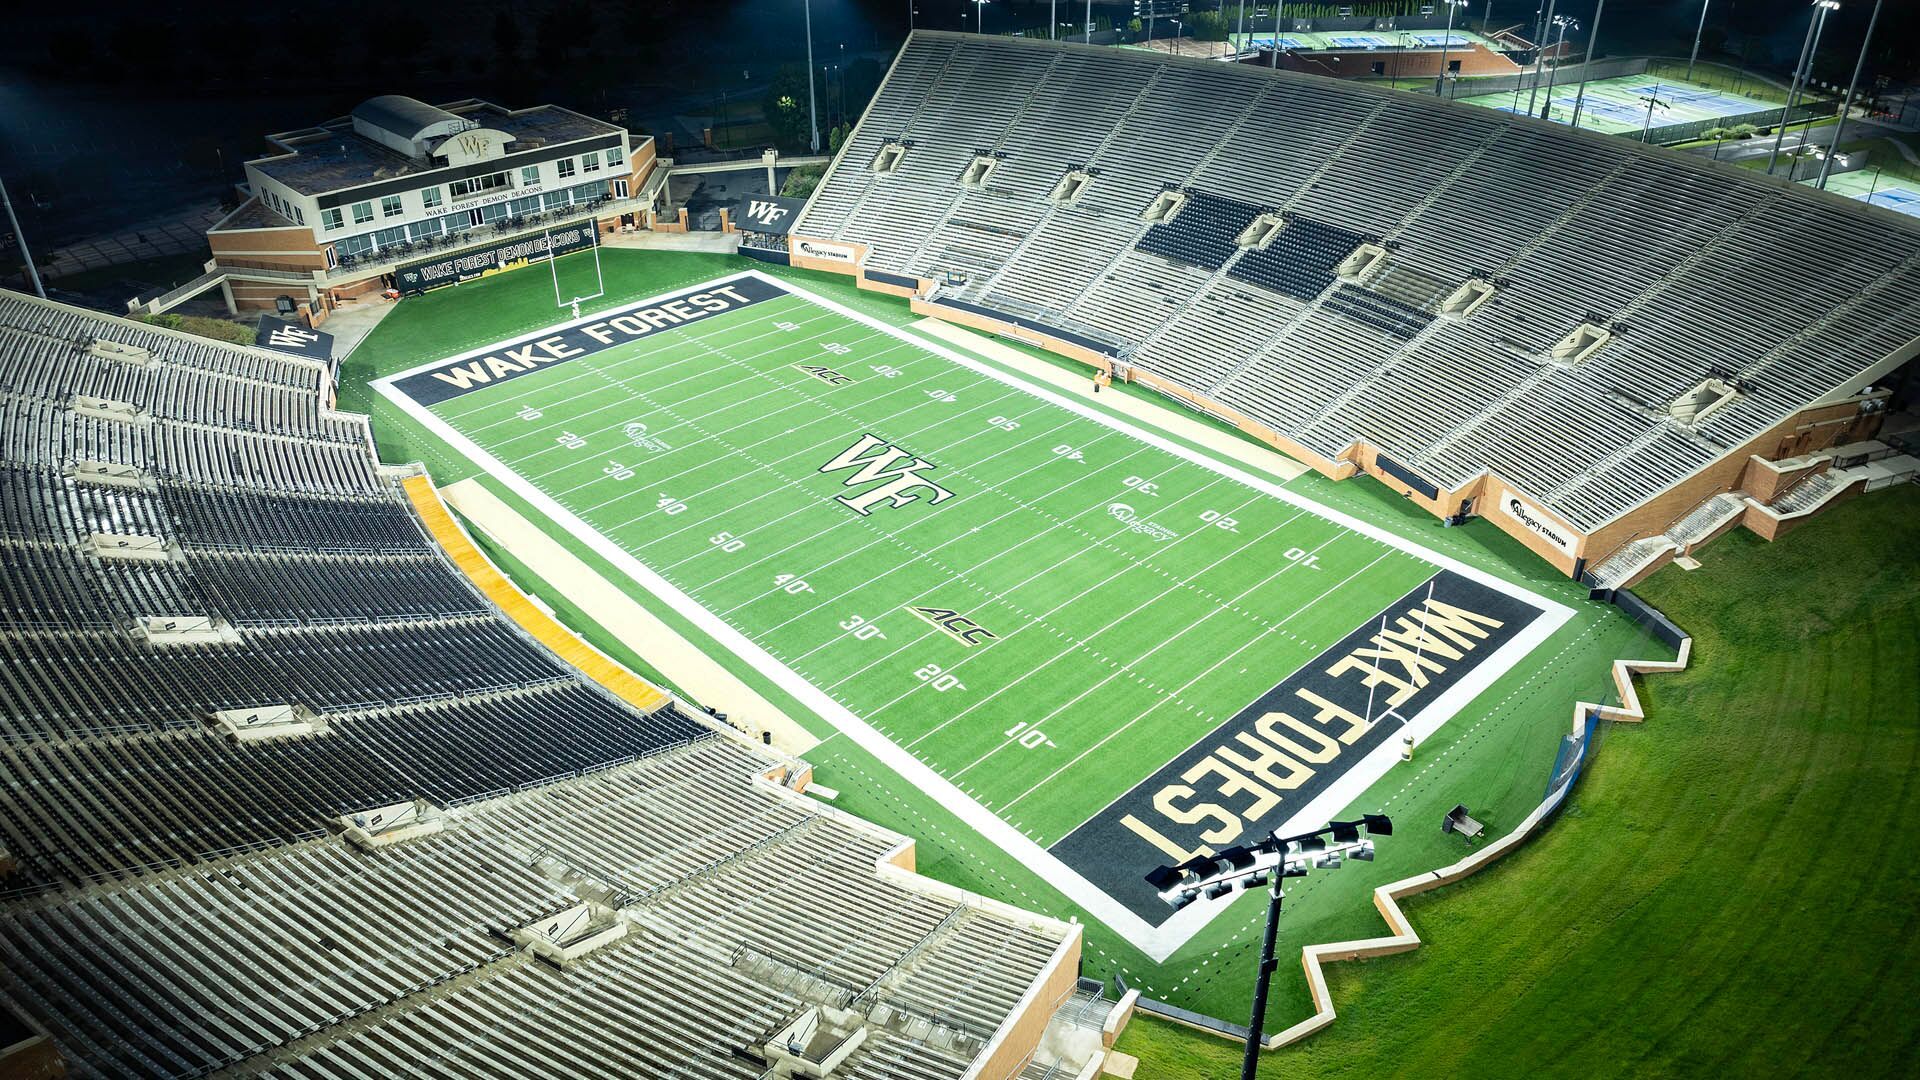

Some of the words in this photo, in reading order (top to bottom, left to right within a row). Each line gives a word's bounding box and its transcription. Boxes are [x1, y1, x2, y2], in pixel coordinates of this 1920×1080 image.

[425, 207, 448, 217] WAKE
[451, 200, 479, 212] FOREST
[482, 193, 508, 205] DEMON
[511, 185, 543, 198] DEACONS
[747, 200, 789, 225] WF
[421, 261, 455, 281] WAKE
[454, 251, 496, 273] FOREST
[496, 241, 535, 263] DEMON
[534, 229, 581, 253] DEACONS
[803, 246, 828, 258] Allegacy
[827, 251, 848, 259] STADIUM
[269, 325, 319, 347] WF
[777, 321, 800, 332] 10
[432, 336, 585, 390] WAKE
[580, 285, 752, 345] FOREST
[824, 342, 853, 355] 20
[797, 365, 855, 386] ACC
[874, 365, 903, 378] 30
[928, 389, 958, 402] 40
[516, 407, 543, 421] 10
[987, 415, 1021, 432] 50
[555, 432, 587, 450] 20
[1052, 444, 1084, 460] 40
[603, 463, 635, 481] 30
[818, 432, 957, 517] WF
[1122, 476, 1159, 495] 30
[656, 496, 688, 515] 40
[1199, 509, 1239, 530] 20
[1513, 502, 1543, 532] Allegacy
[1541, 528, 1567, 548] STADIUM
[709, 531, 745, 553] 50
[1283, 547, 1320, 567] 10
[774, 573, 809, 594] 40
[839, 615, 880, 640] 30
[914, 607, 998, 645] ACC
[1325, 598, 1504, 706] WAKE
[913, 663, 958, 692] 20
[1004, 721, 1047, 749] 10
[1119, 687, 1375, 878] FOREST
